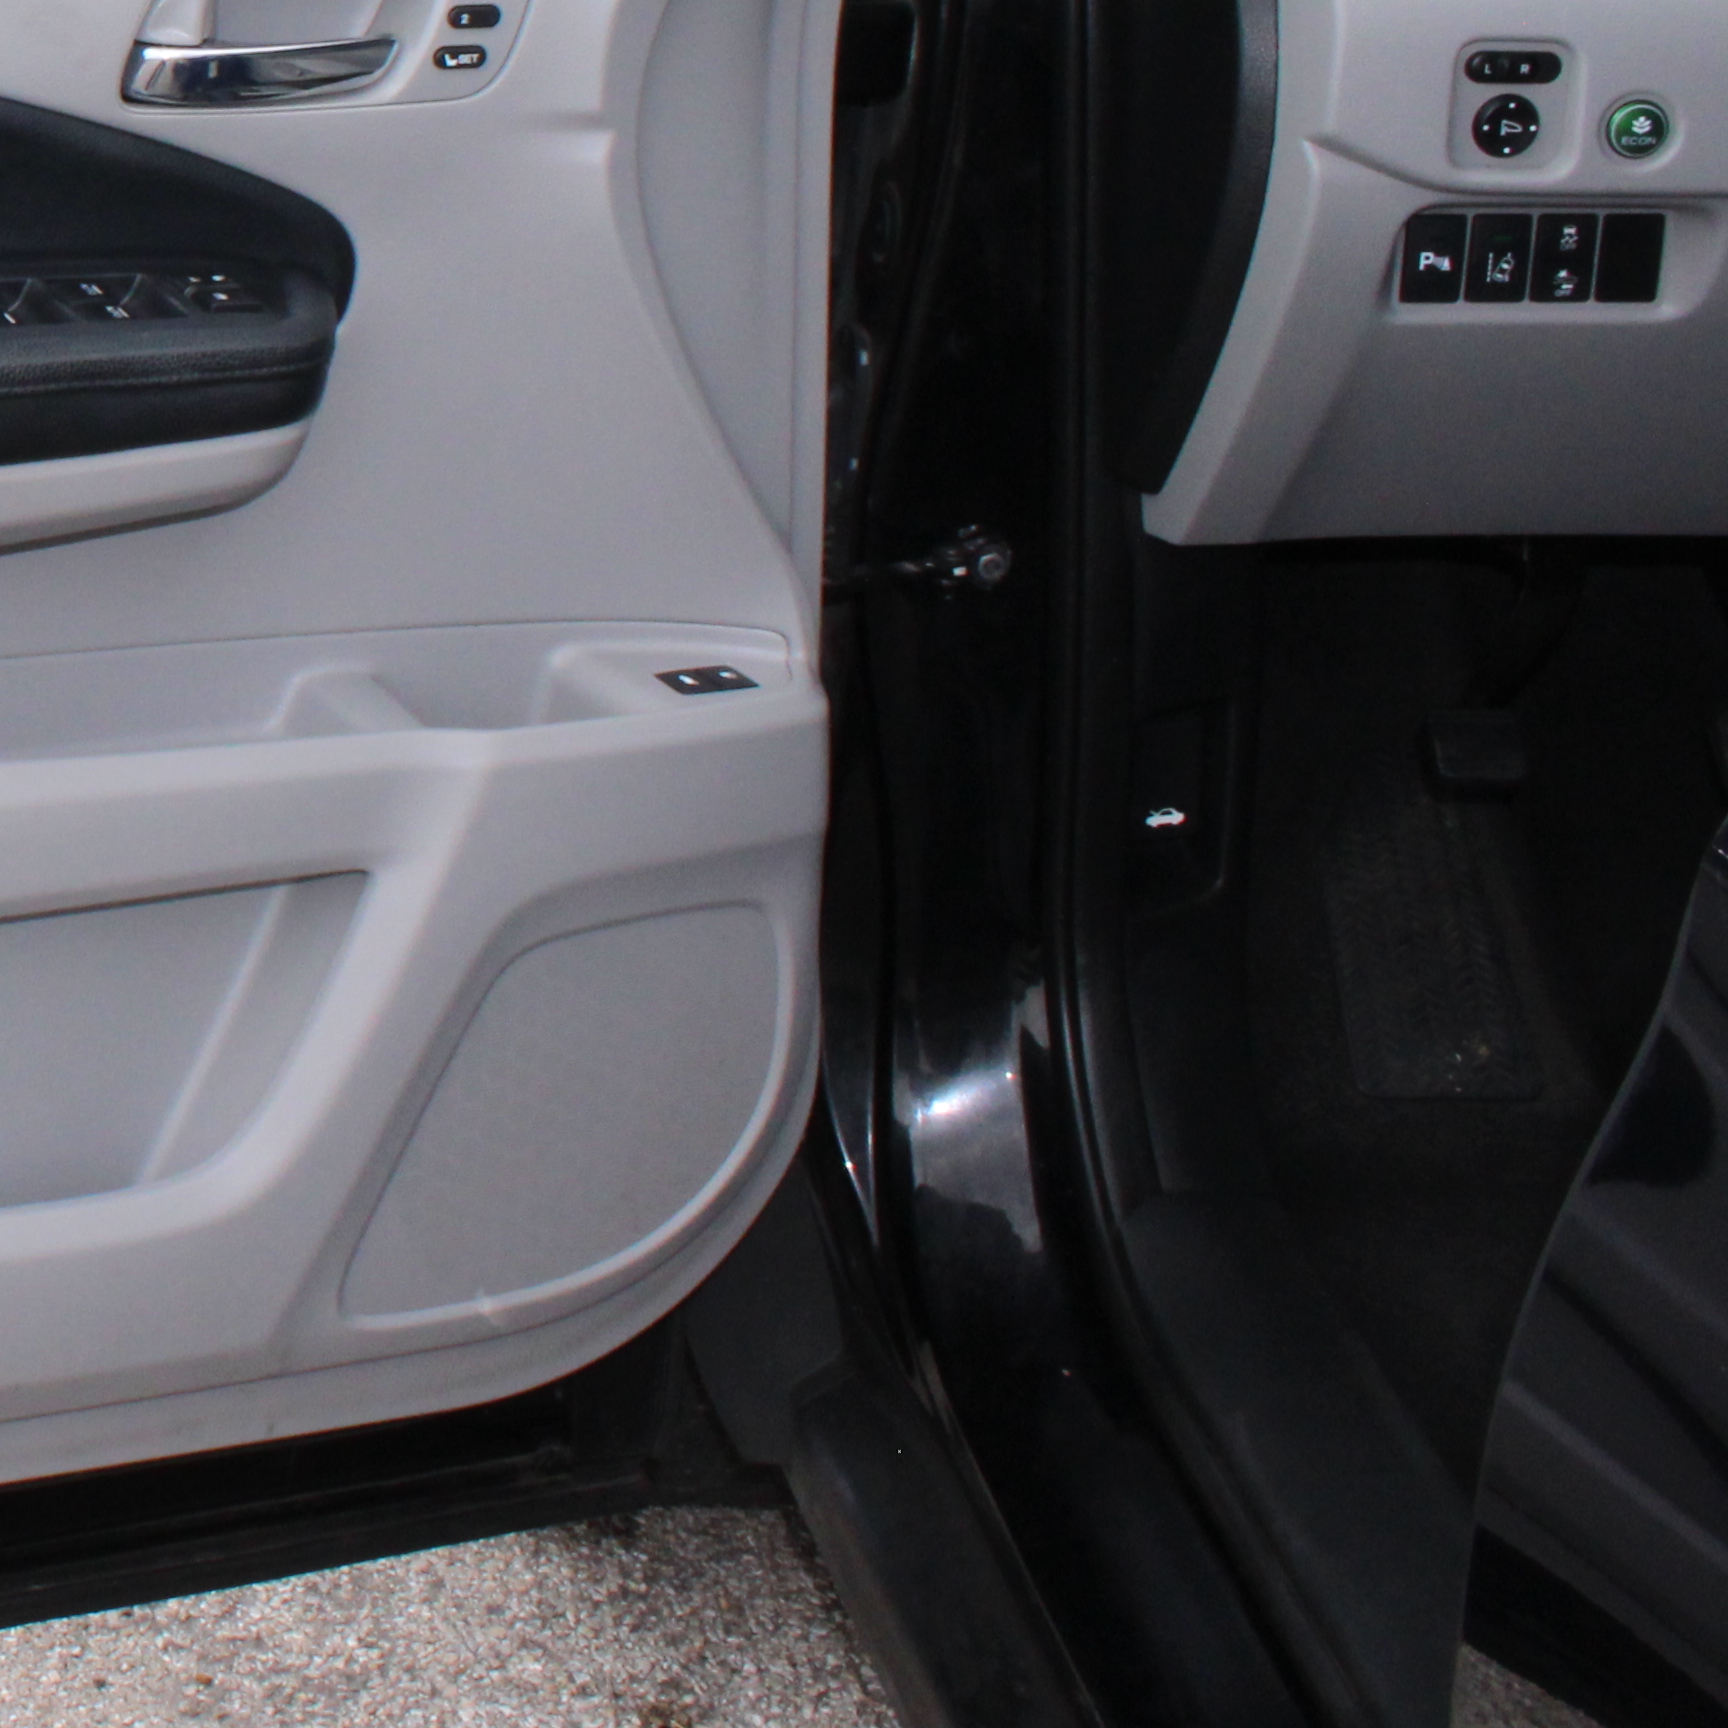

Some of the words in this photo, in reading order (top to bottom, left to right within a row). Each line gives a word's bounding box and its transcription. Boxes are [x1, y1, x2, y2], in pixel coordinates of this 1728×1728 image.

[460, 13, 470, 25] 2
[1484, 64, 1492, 74] L
[1520, 64, 1530, 74] R
[1621, 135, 1657, 147] ECON
